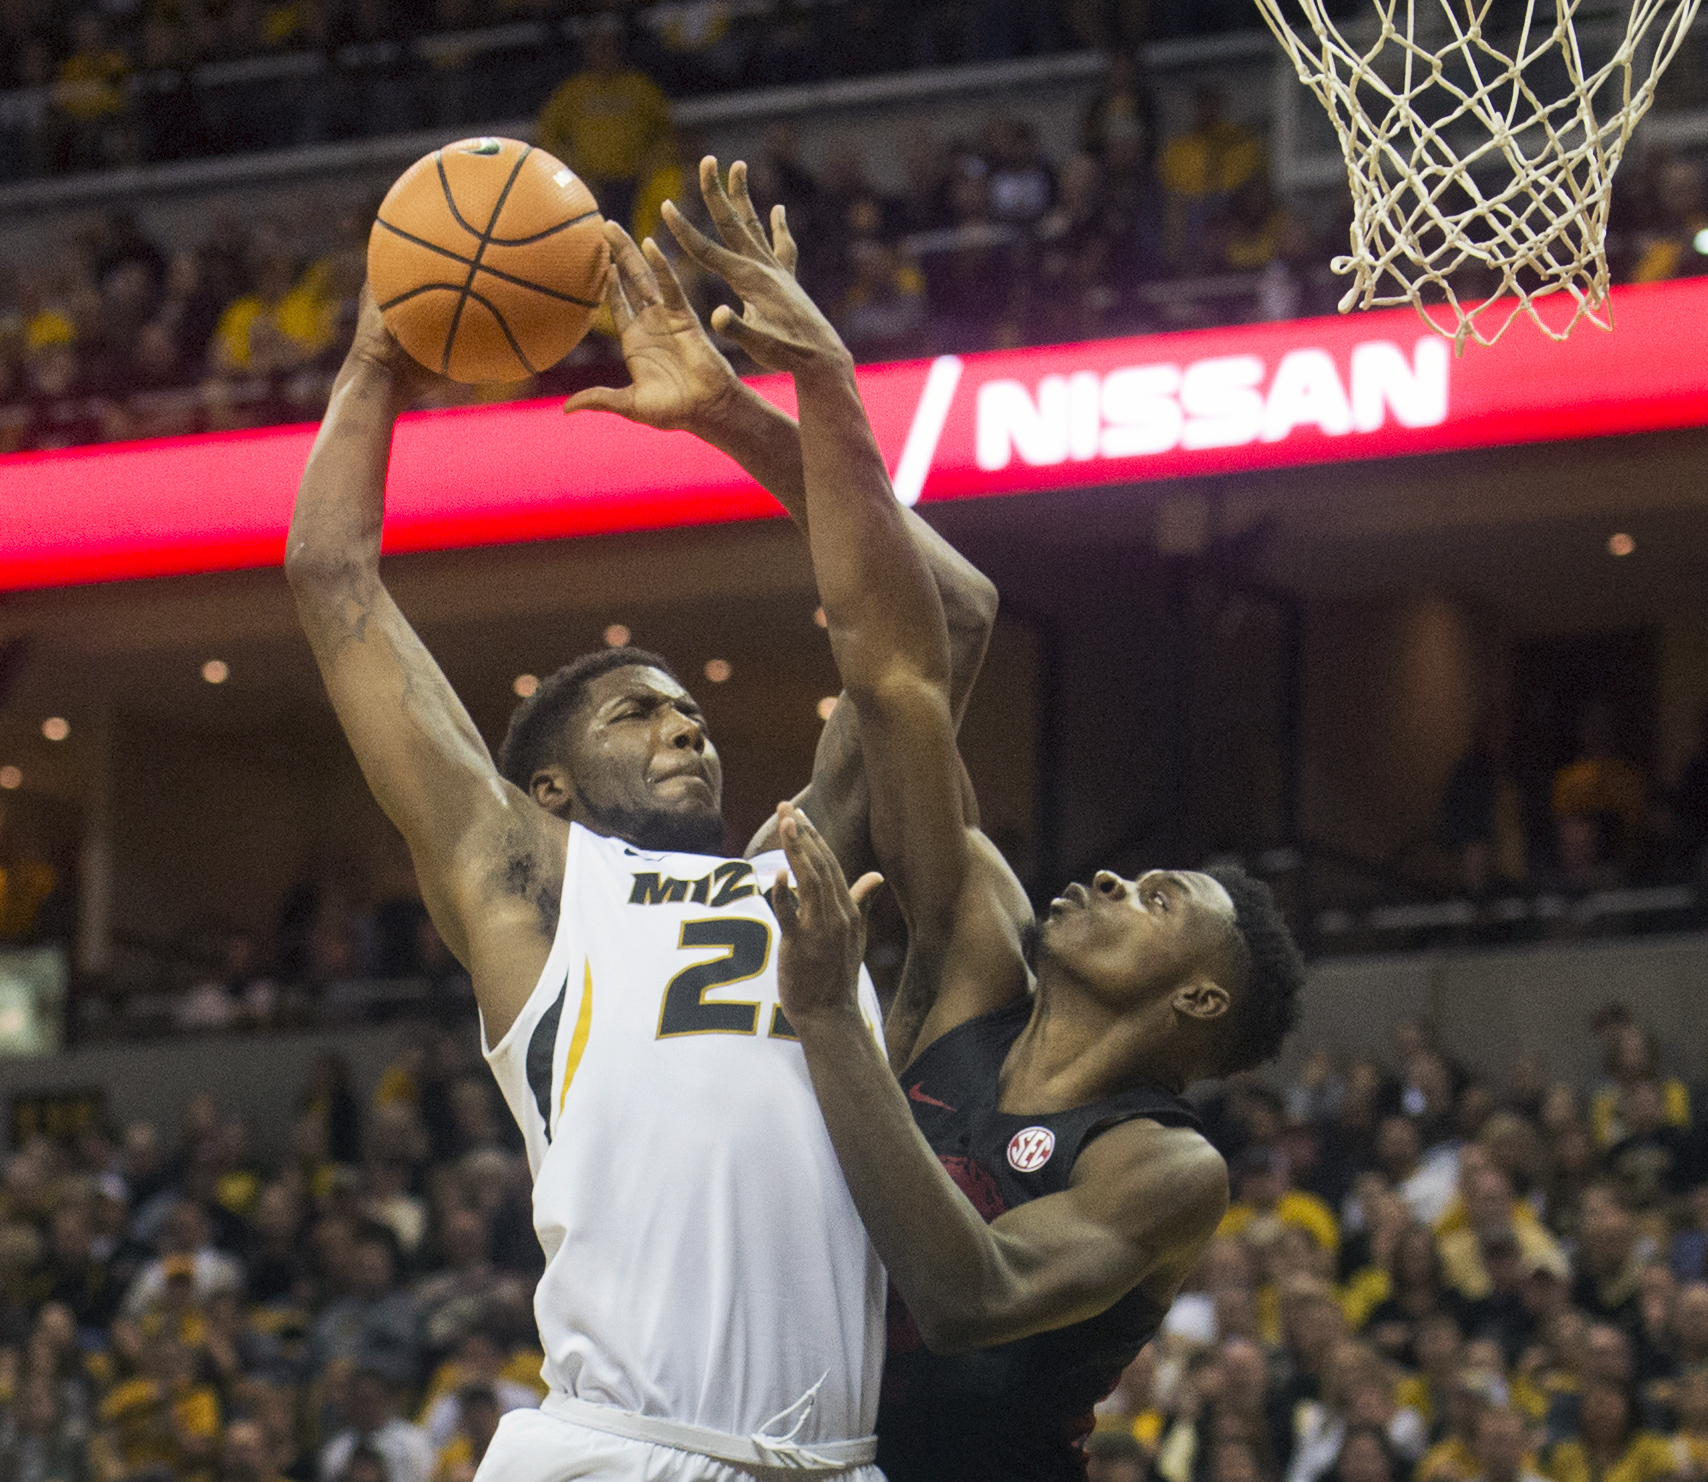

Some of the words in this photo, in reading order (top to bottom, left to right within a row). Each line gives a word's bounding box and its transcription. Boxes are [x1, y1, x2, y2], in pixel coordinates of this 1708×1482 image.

[977, 336, 1450, 470] NISSAN
[655, 916, 802, 1041] 2
[1009, 1128, 1053, 1170] SEC
